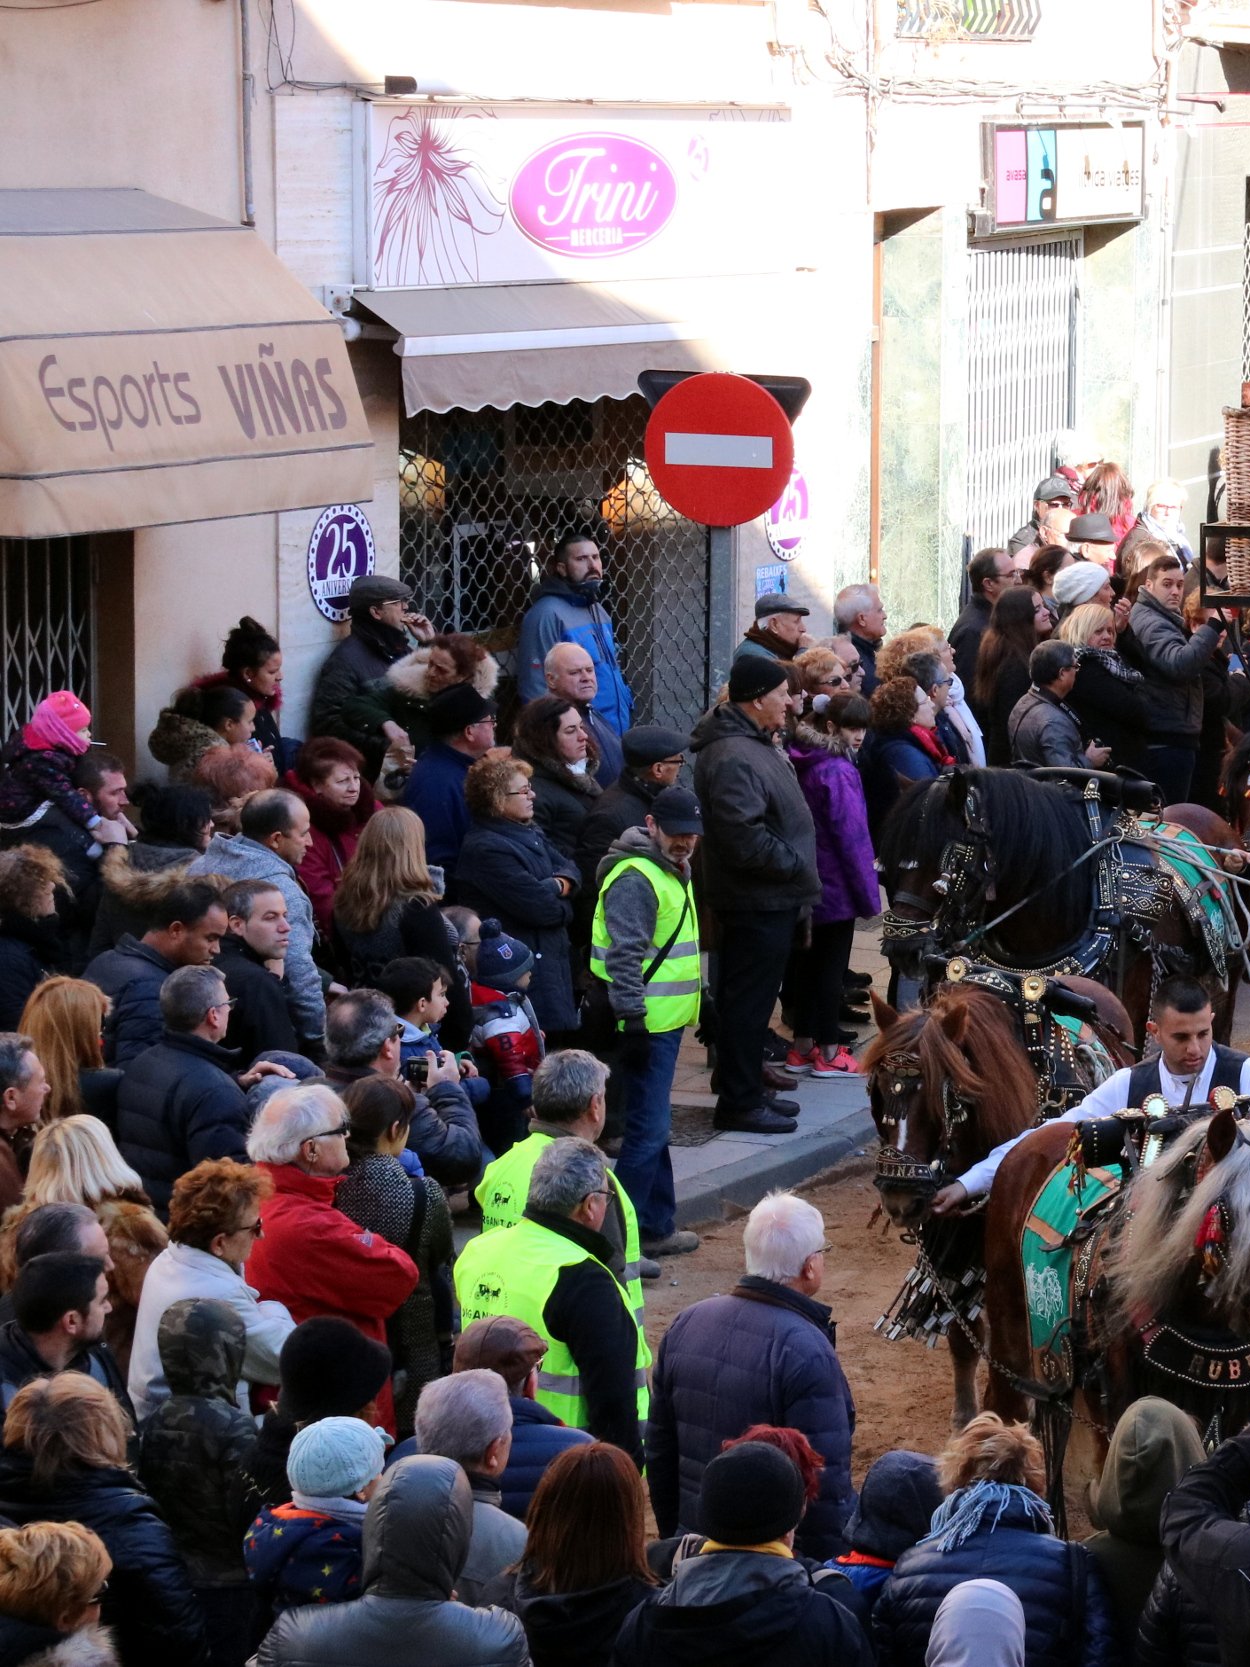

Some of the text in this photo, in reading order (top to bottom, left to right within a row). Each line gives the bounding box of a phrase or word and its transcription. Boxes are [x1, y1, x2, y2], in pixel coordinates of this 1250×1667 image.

[537, 147, 660, 226] Trini
[38, 342, 348, 452] Esports VIÑAS
[325, 522, 357, 578] 25
